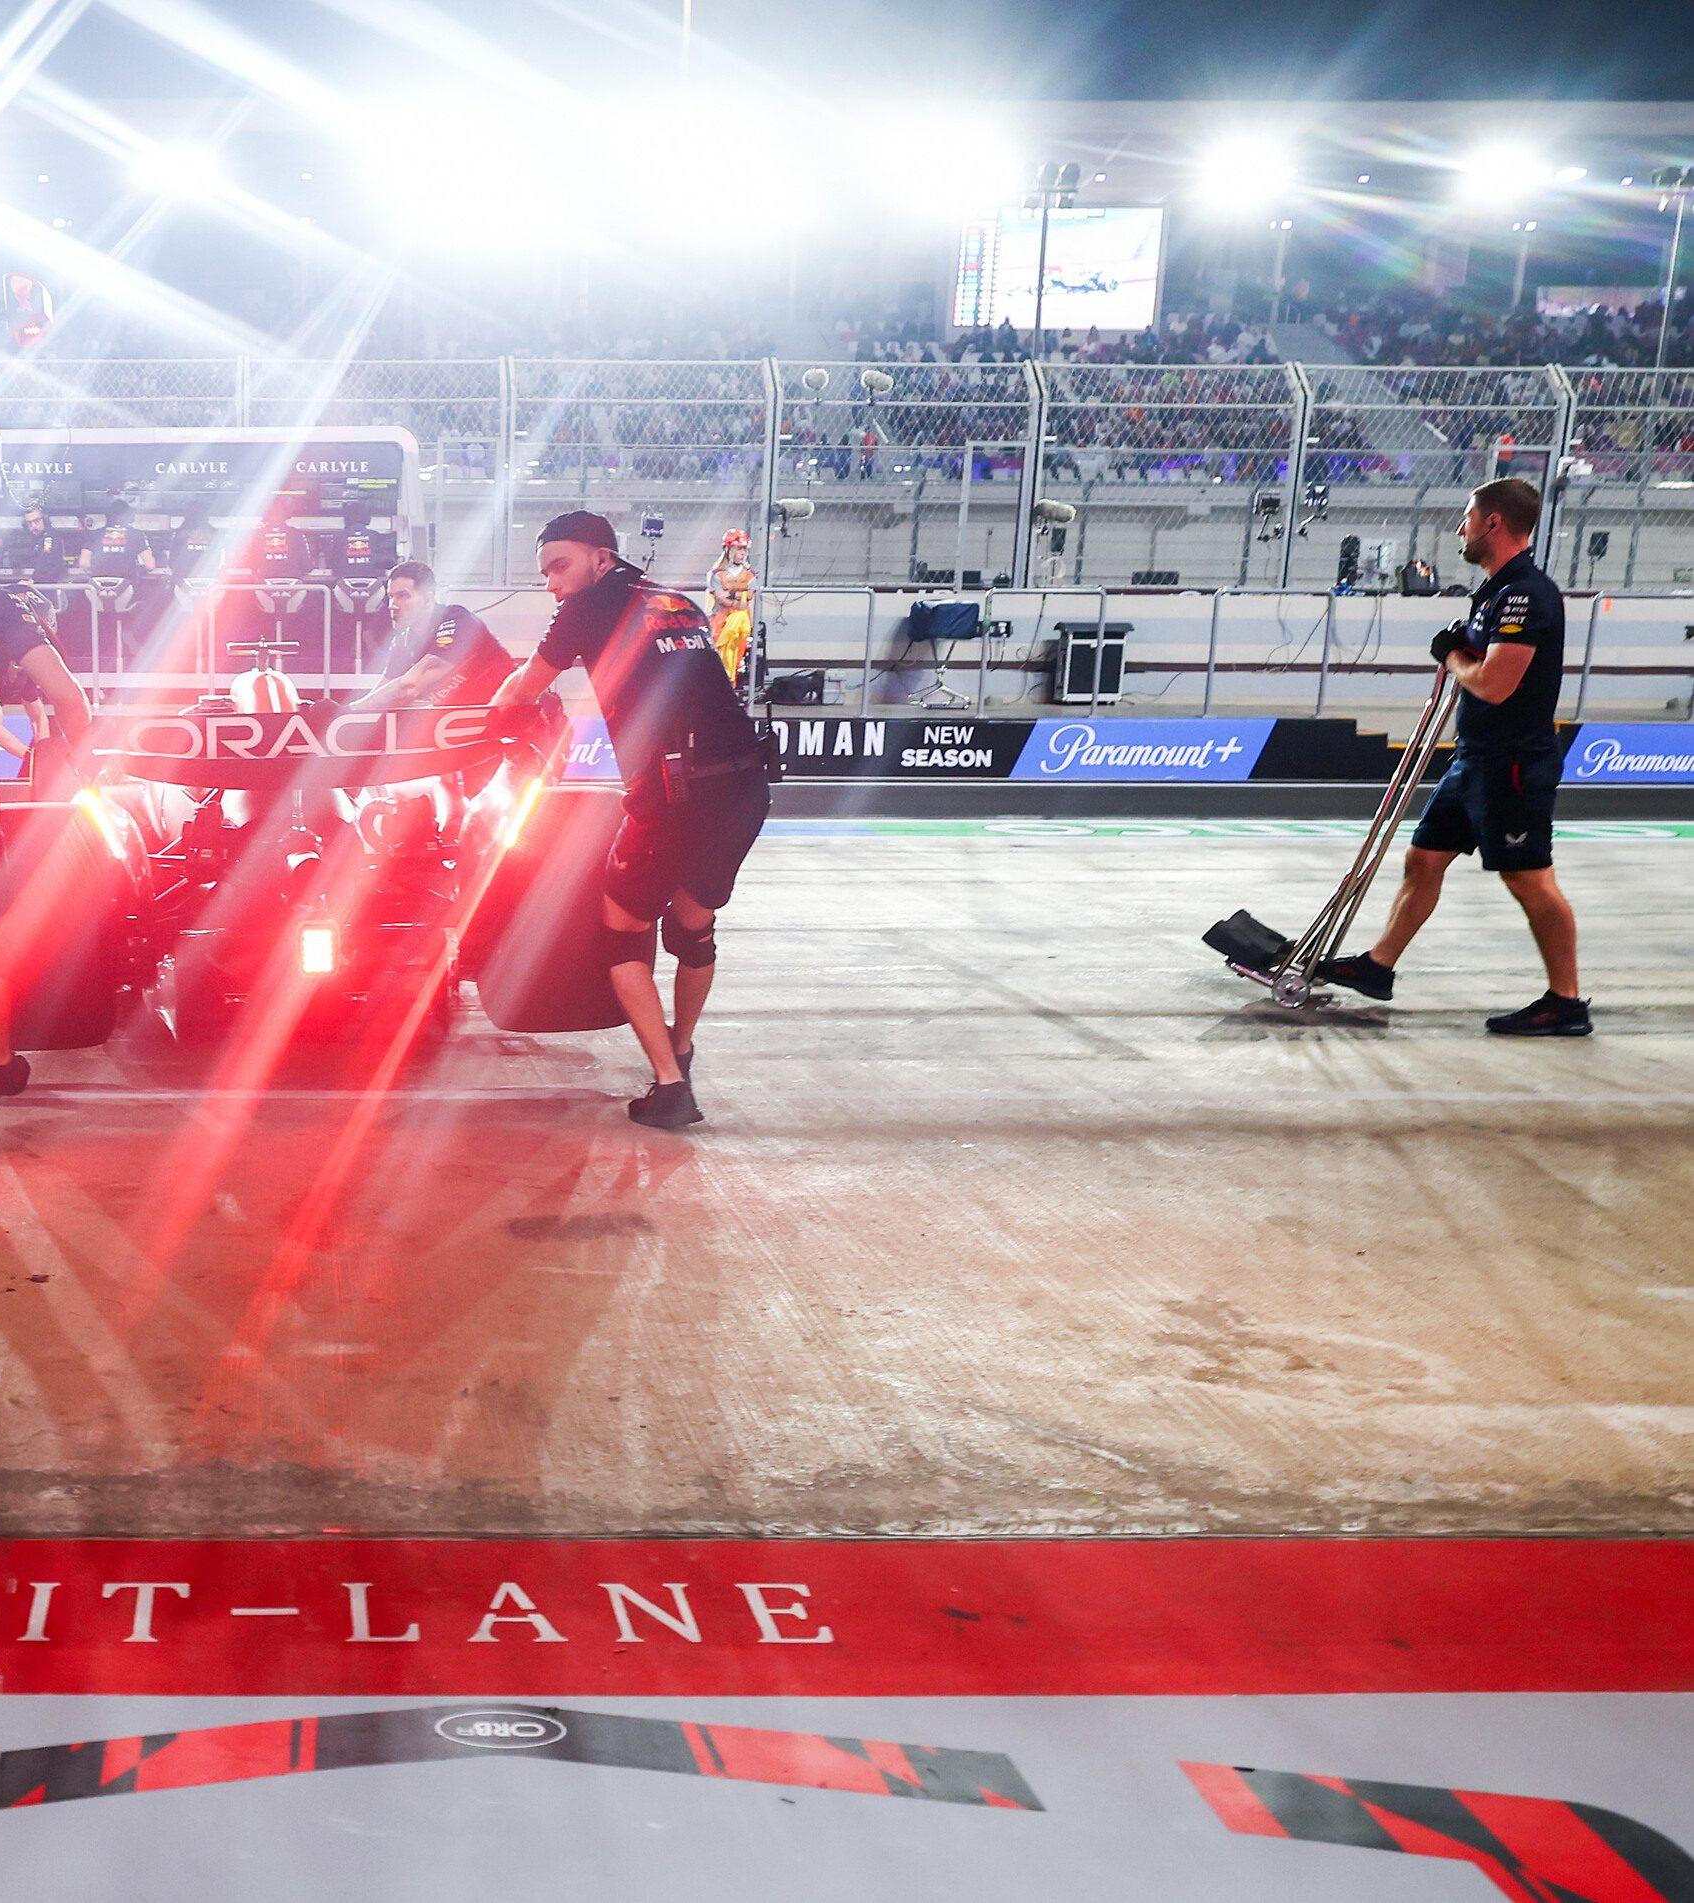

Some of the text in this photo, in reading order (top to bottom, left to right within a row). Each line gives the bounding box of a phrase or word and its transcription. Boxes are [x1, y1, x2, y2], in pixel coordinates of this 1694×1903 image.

[1, 462, 74, 475] CARLYLE
[155, 462, 229, 474] CARLYLE
[295, 461, 370, 473] CARLYLE
[1507, 595, 1530, 604] VISA
[655, 634, 706, 654] Mobil
[126, 708, 493, 760] ORACLE
[922, 726, 975, 745] NEW
[1040, 723, 1244, 774] Paramount+
[900, 749, 993, 768] SEASON
